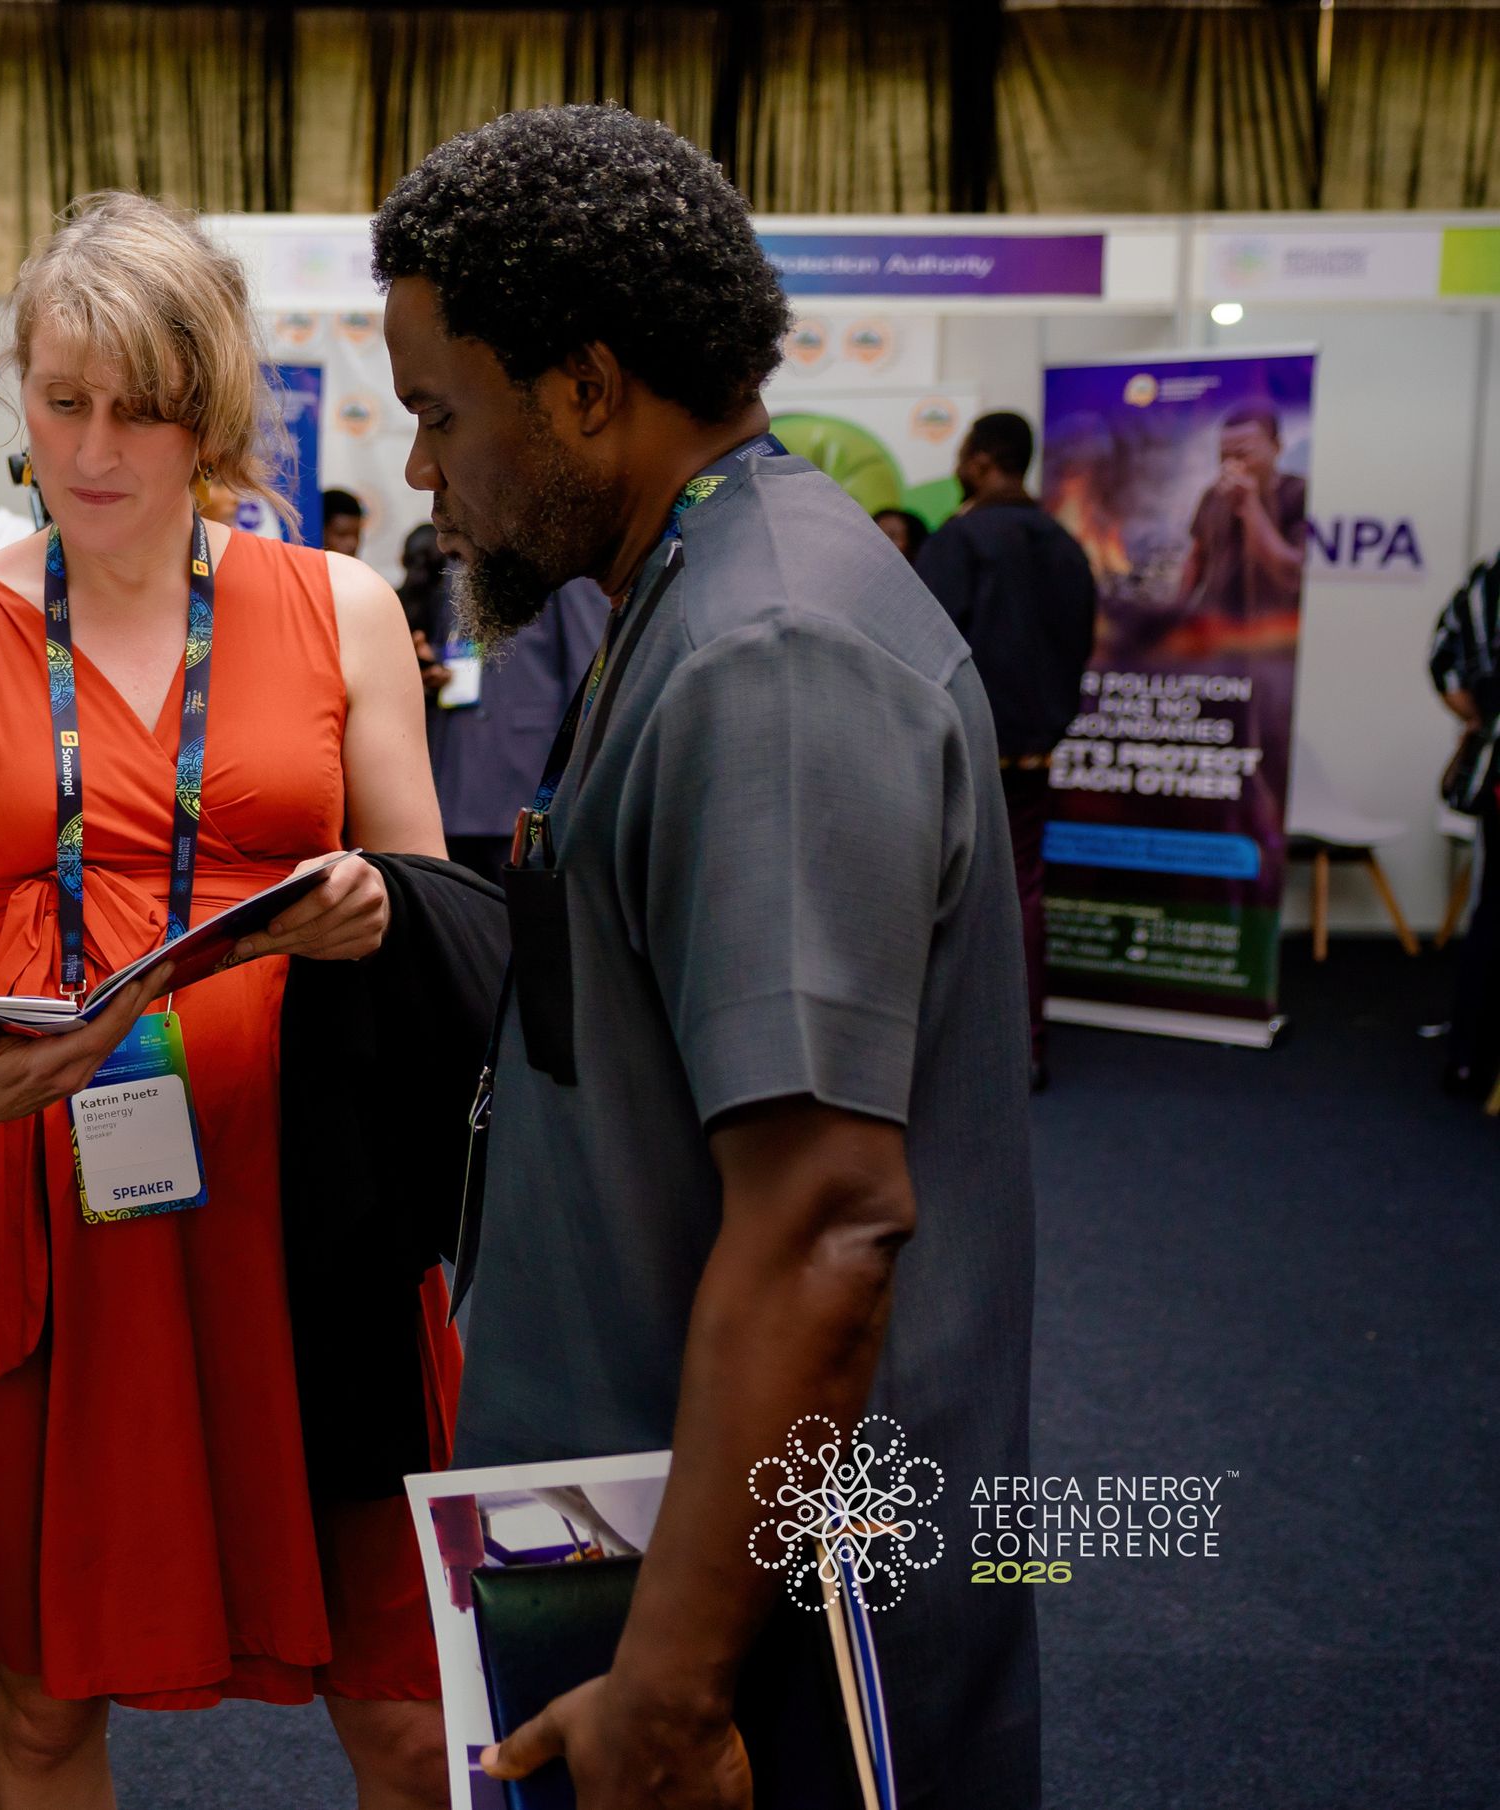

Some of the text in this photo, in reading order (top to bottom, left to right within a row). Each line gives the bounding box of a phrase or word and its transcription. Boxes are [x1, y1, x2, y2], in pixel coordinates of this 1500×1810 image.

[884, 253, 995, 279] Authority
[1306, 519, 1423, 567] NPA
[1102, 672, 1252, 701] POLLUTION
[1100, 694, 1201, 721] HAS NO
[1051, 739, 1263, 776] ET'S PROTECT
[61, 748, 75, 797] Sonangol
[1049, 766, 1242, 800] EACH OTHER
[80, 1088, 159, 1109] Katrin Puetz
[83, 1107, 133, 1124] (B)energy
[84, 1121, 117, 1133] (B)energy
[85, 1131, 113, 1141] Speaker
[112, 1180, 173, 1200] SPEAKER
